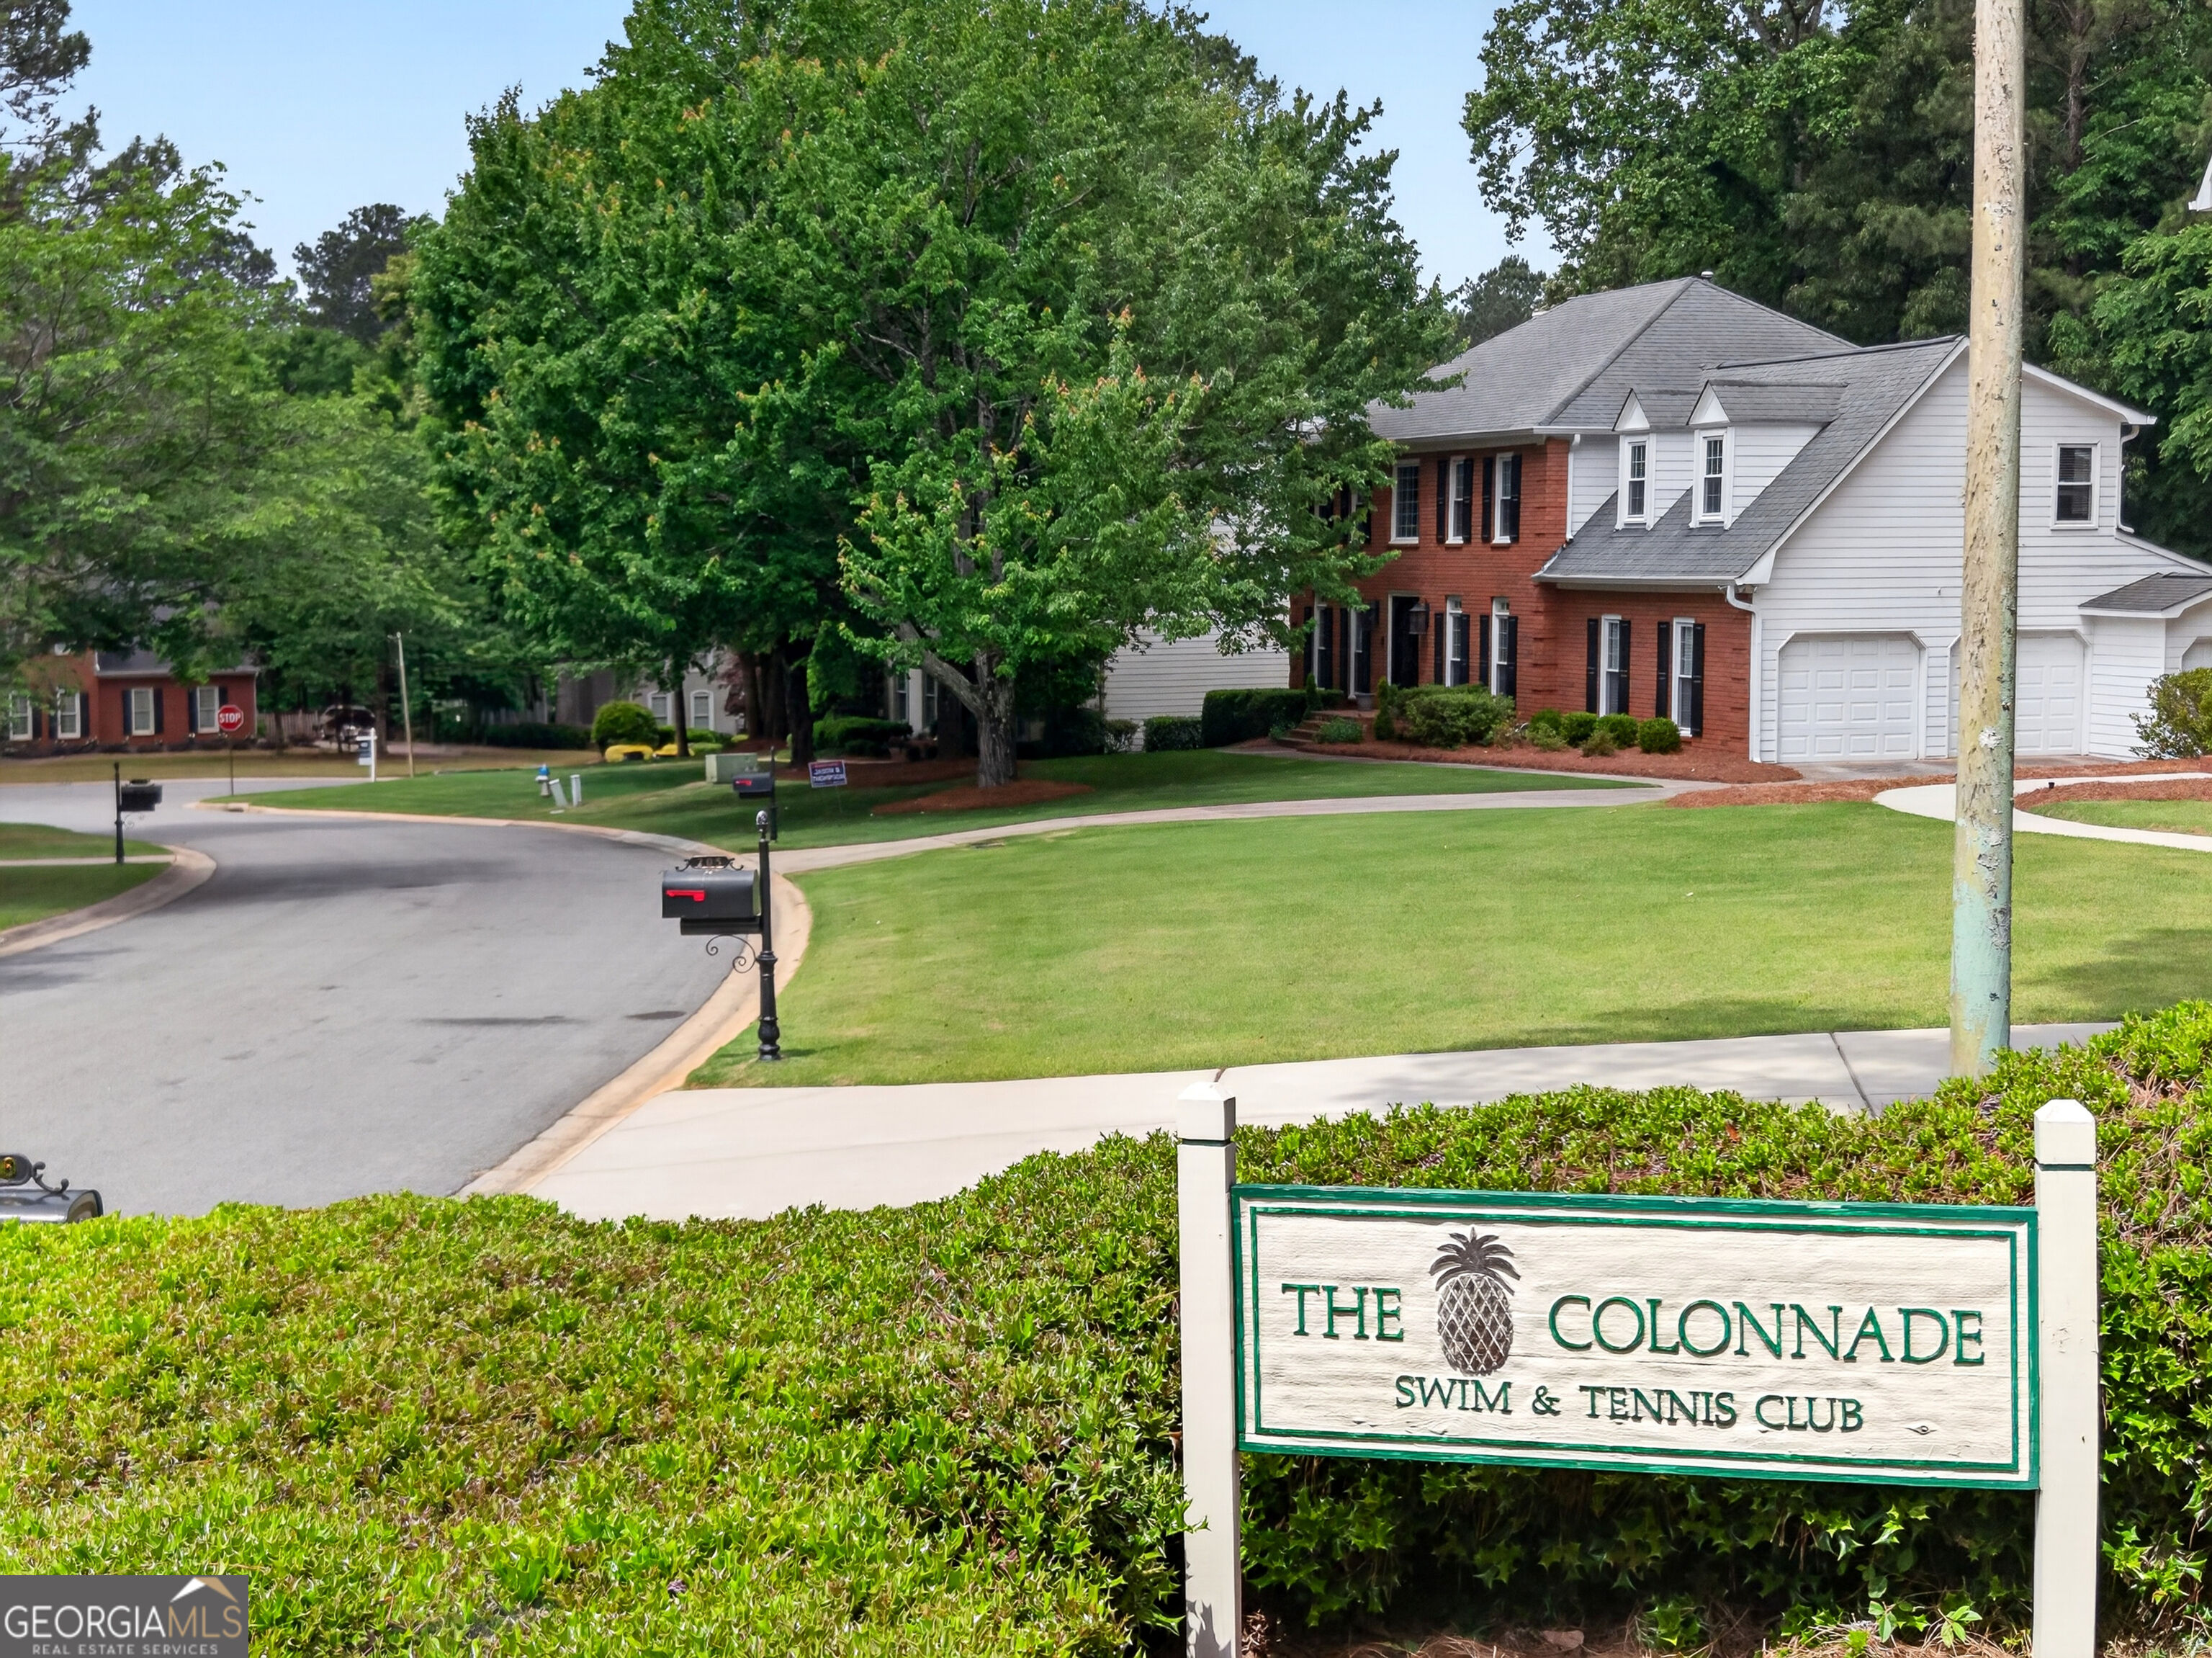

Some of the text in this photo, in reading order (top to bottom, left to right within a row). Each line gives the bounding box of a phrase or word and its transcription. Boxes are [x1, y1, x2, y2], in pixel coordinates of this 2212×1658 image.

[219, 713, 241, 723] STOP
[1282, 1283, 1984, 1366] THE COLONNADE
[1396, 1376, 1863, 1432] SWIM & TENNIS CLUB
